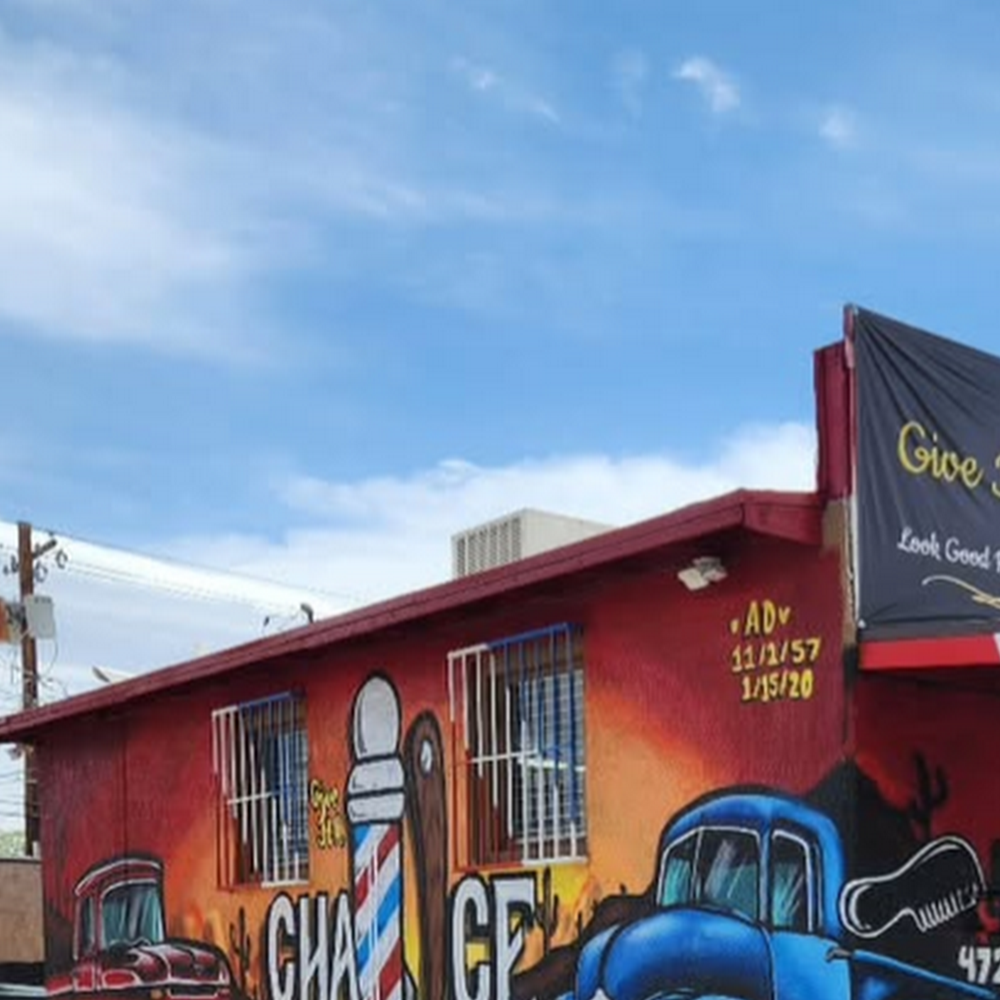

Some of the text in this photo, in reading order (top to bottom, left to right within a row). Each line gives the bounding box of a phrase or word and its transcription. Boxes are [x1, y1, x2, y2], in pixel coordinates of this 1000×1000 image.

[898, 421, 984, 488] Give
[897, 527, 941, 561] Look
[945, 537, 990, 570] Good
